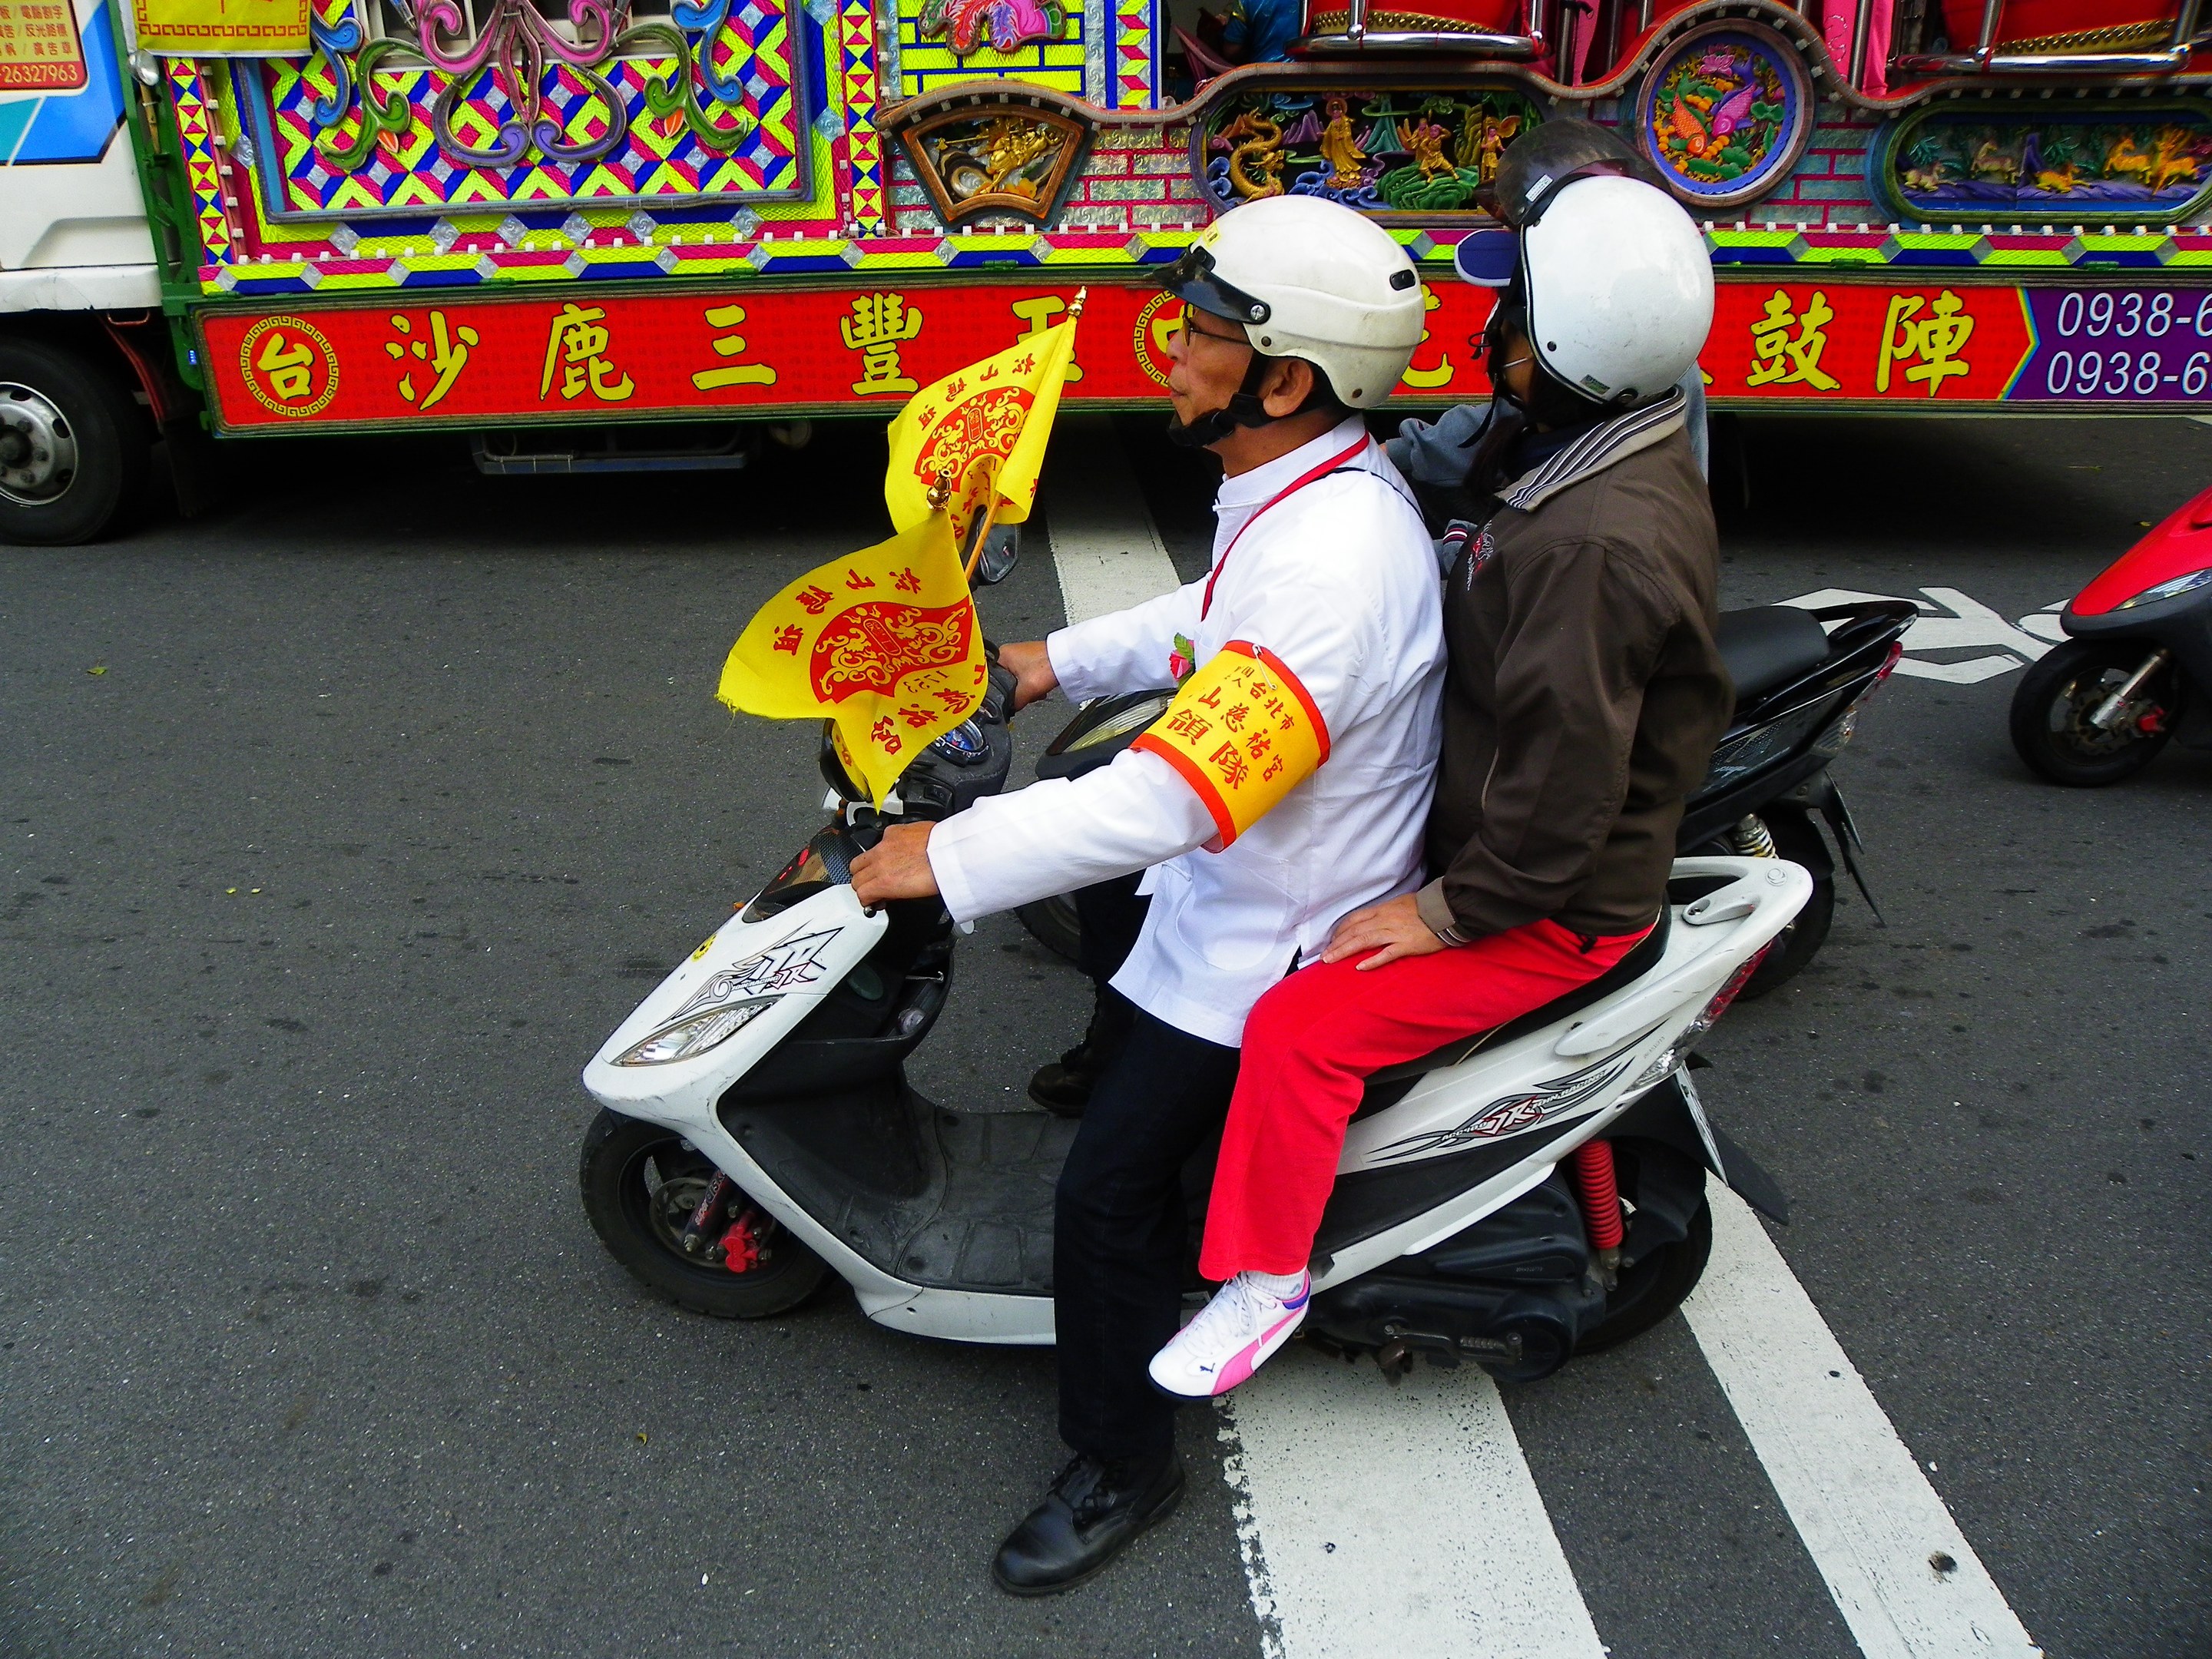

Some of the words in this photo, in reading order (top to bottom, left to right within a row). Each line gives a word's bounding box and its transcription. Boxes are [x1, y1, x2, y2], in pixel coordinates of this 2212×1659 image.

[1250, 680, 1295, 730] 台北市
[1167, 708, 1249, 790] 領隊
